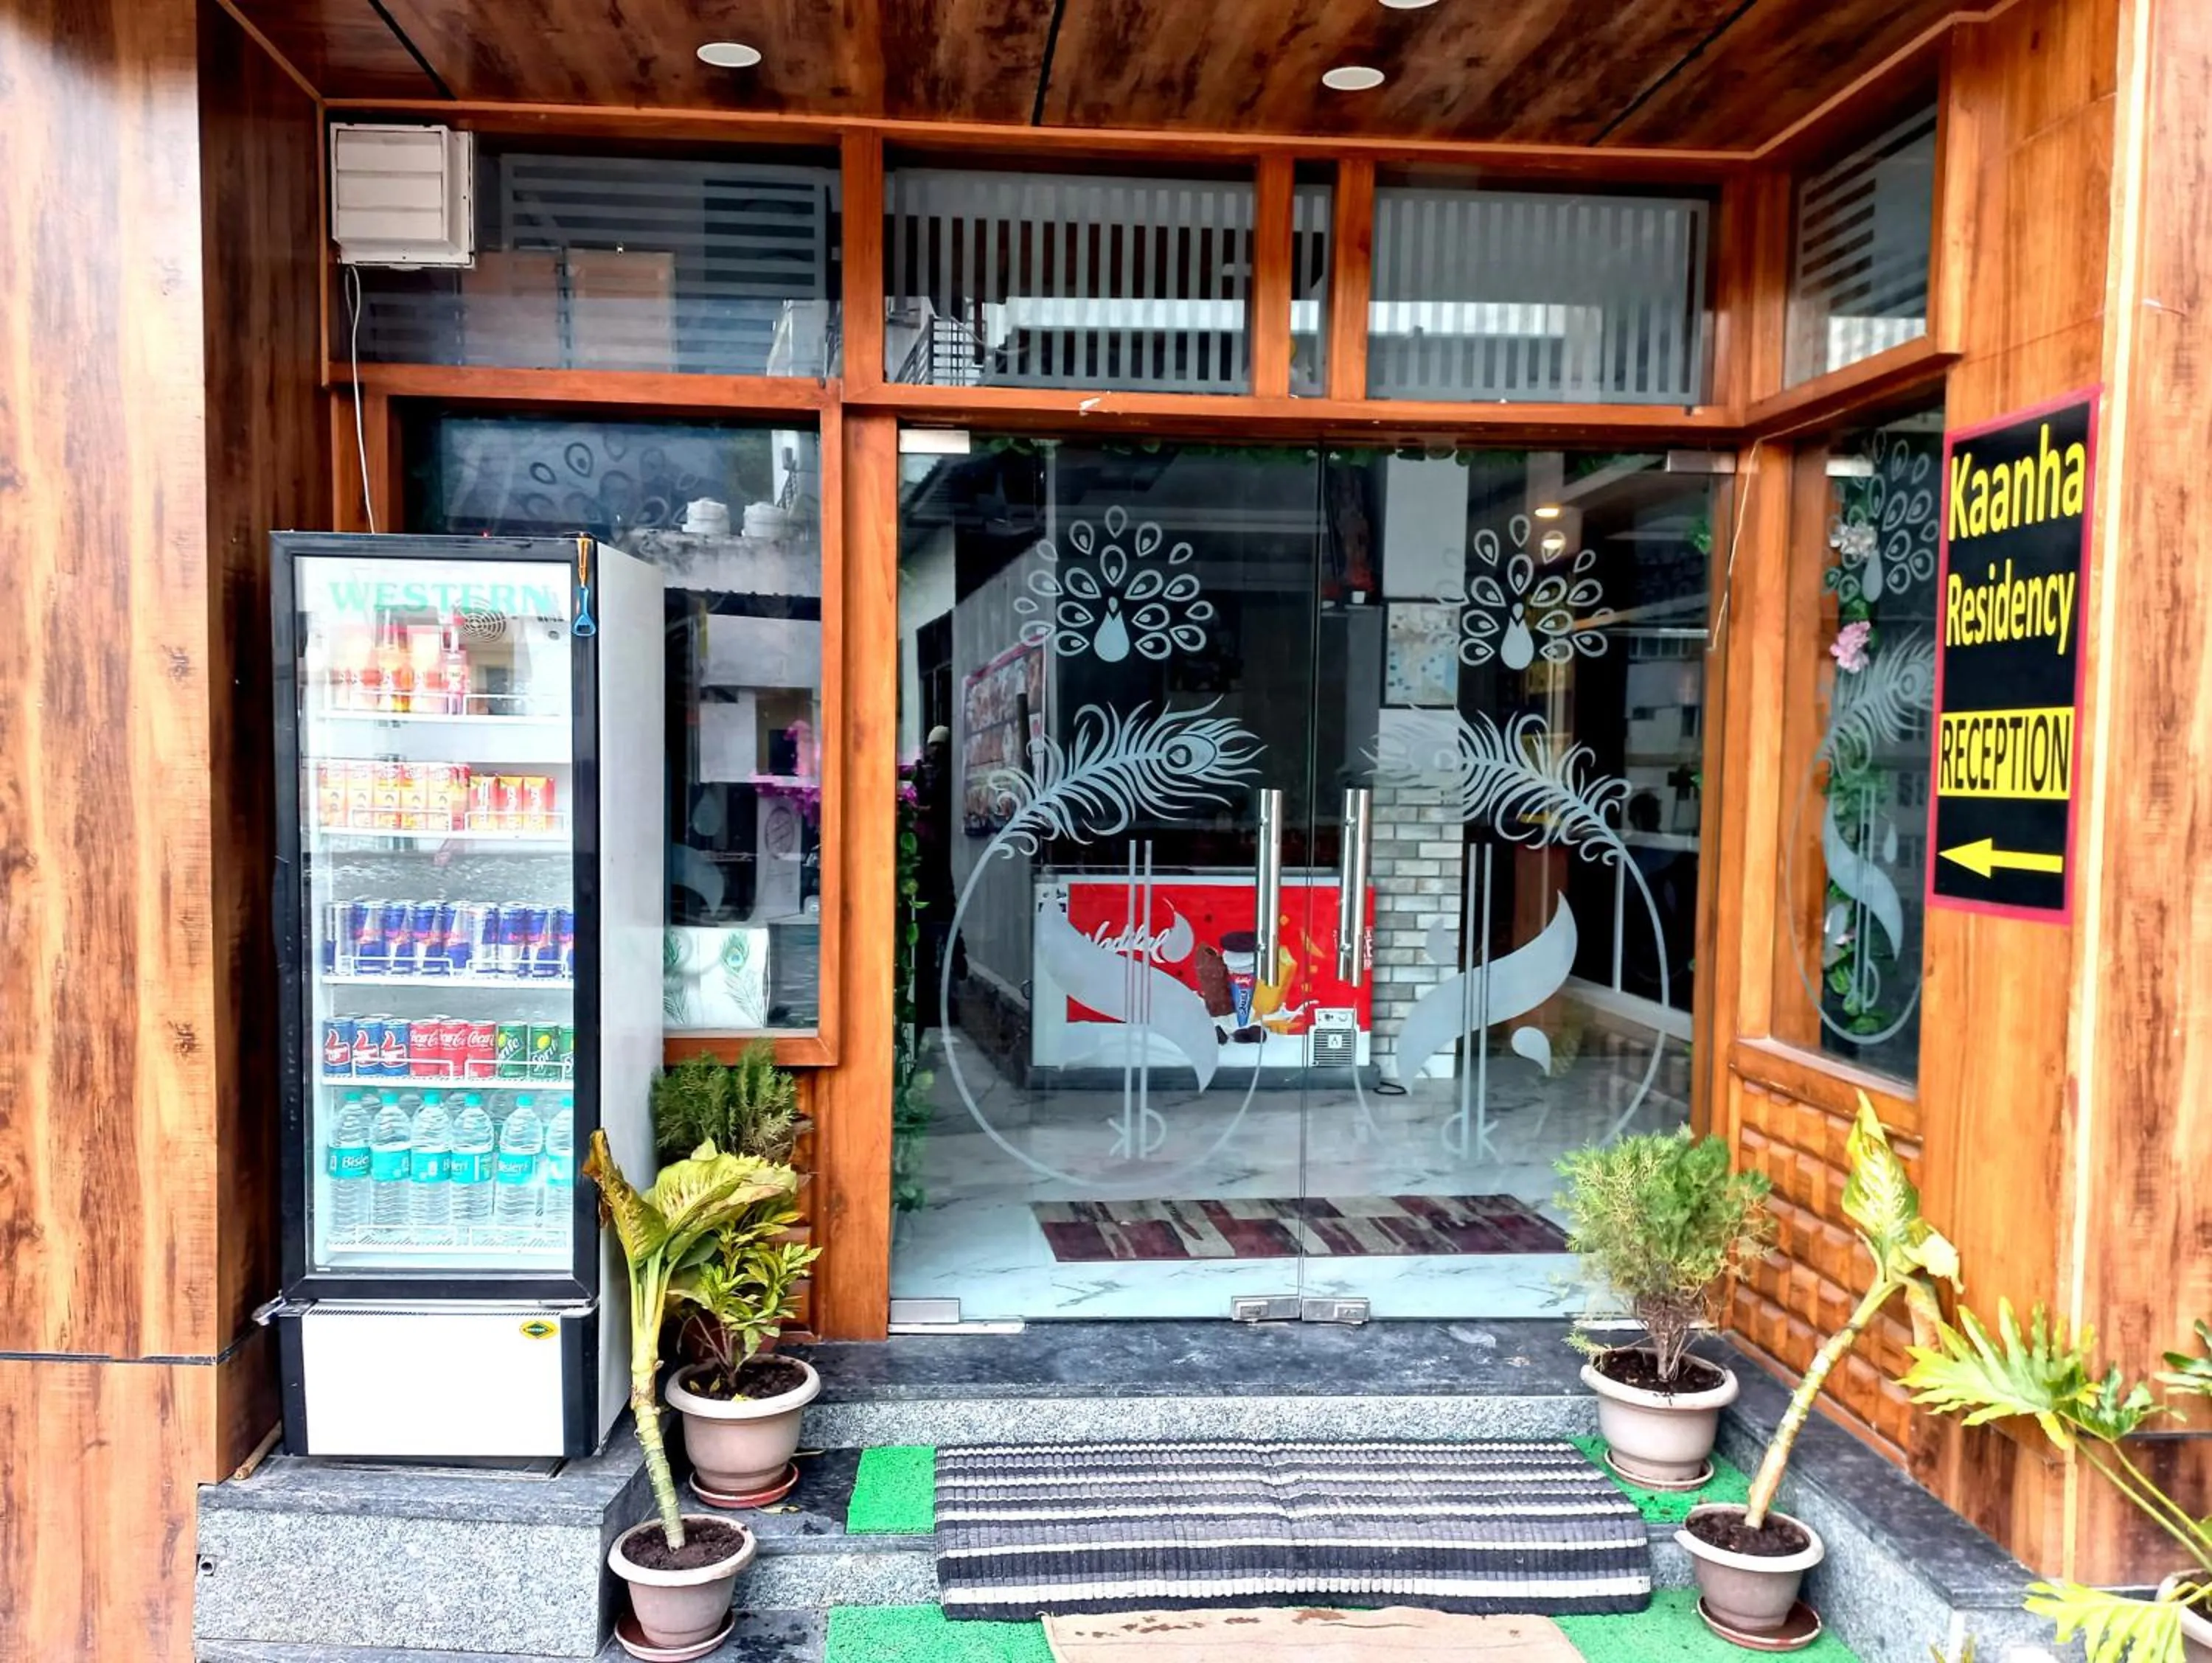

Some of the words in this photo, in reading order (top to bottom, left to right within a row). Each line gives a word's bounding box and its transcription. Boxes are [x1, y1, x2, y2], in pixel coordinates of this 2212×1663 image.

[1948, 423, 2086, 541] Kaanha
[328, 581, 551, 613] WESTERN
[1946, 558, 2076, 655] Residency
[1940, 714, 2070, 792] RECEPTION
